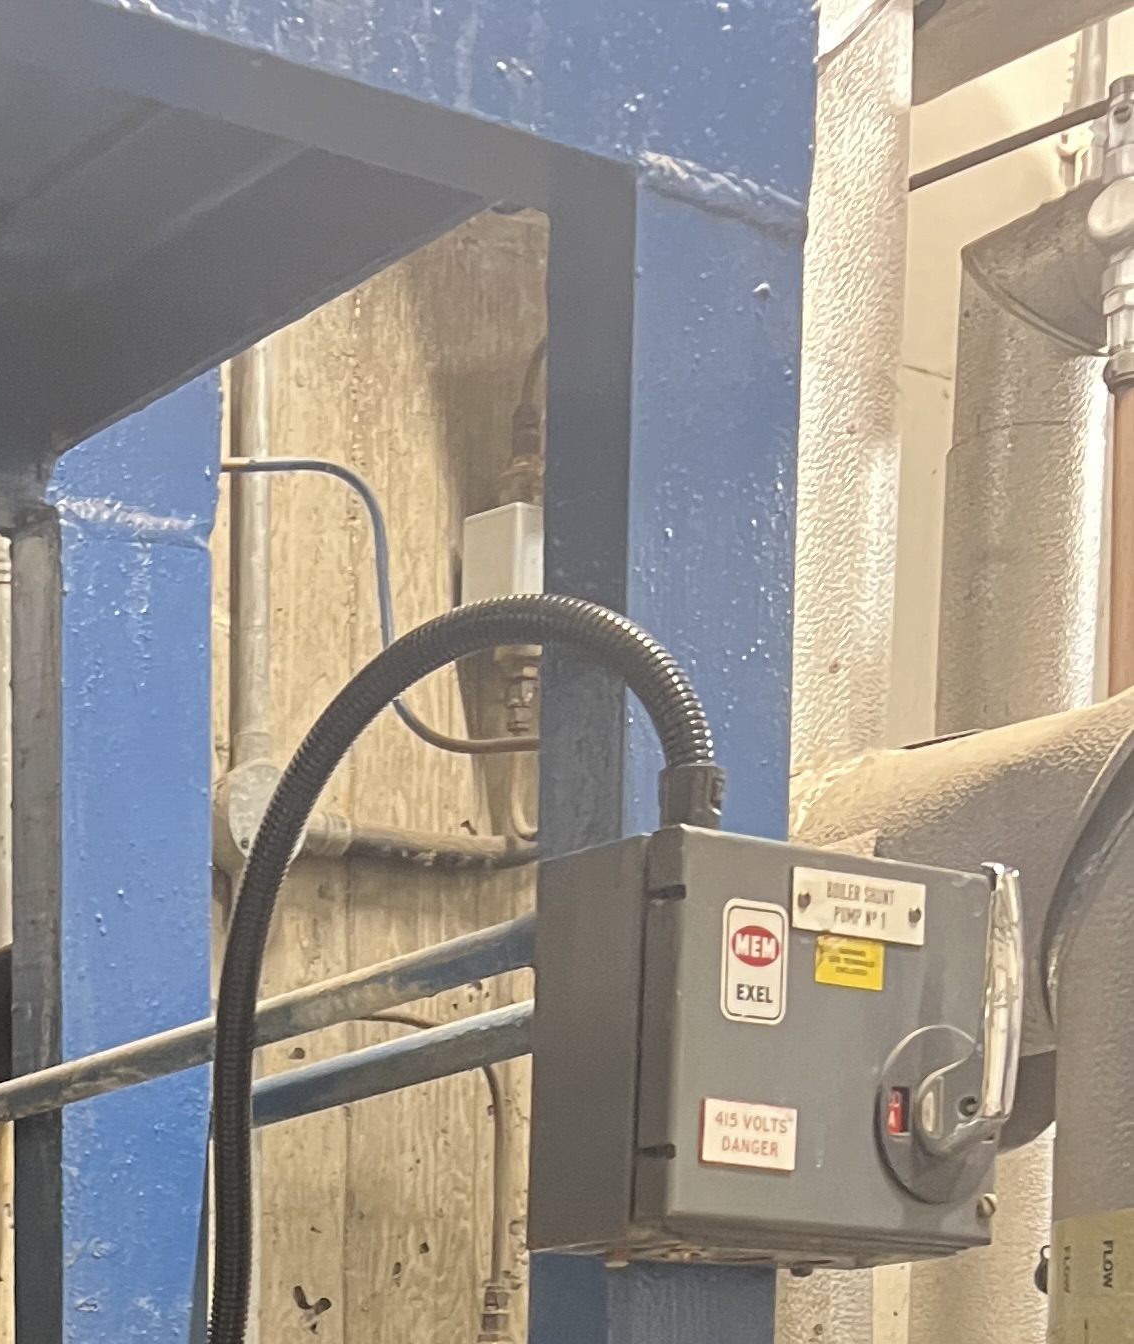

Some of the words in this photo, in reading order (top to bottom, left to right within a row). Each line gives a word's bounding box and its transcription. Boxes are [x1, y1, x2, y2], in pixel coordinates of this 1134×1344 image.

[833, 905, 862, 925] PUMP
[734, 932, 776, 960] MEM
[736, 983, 773, 1004] EXEL
[714, 1110, 738, 1128] 415
[742, 1113, 788, 1134] VOLTS
[721, 1135, 779, 1158] DANGER
[1102, 1239, 1114, 1289] FLOW
